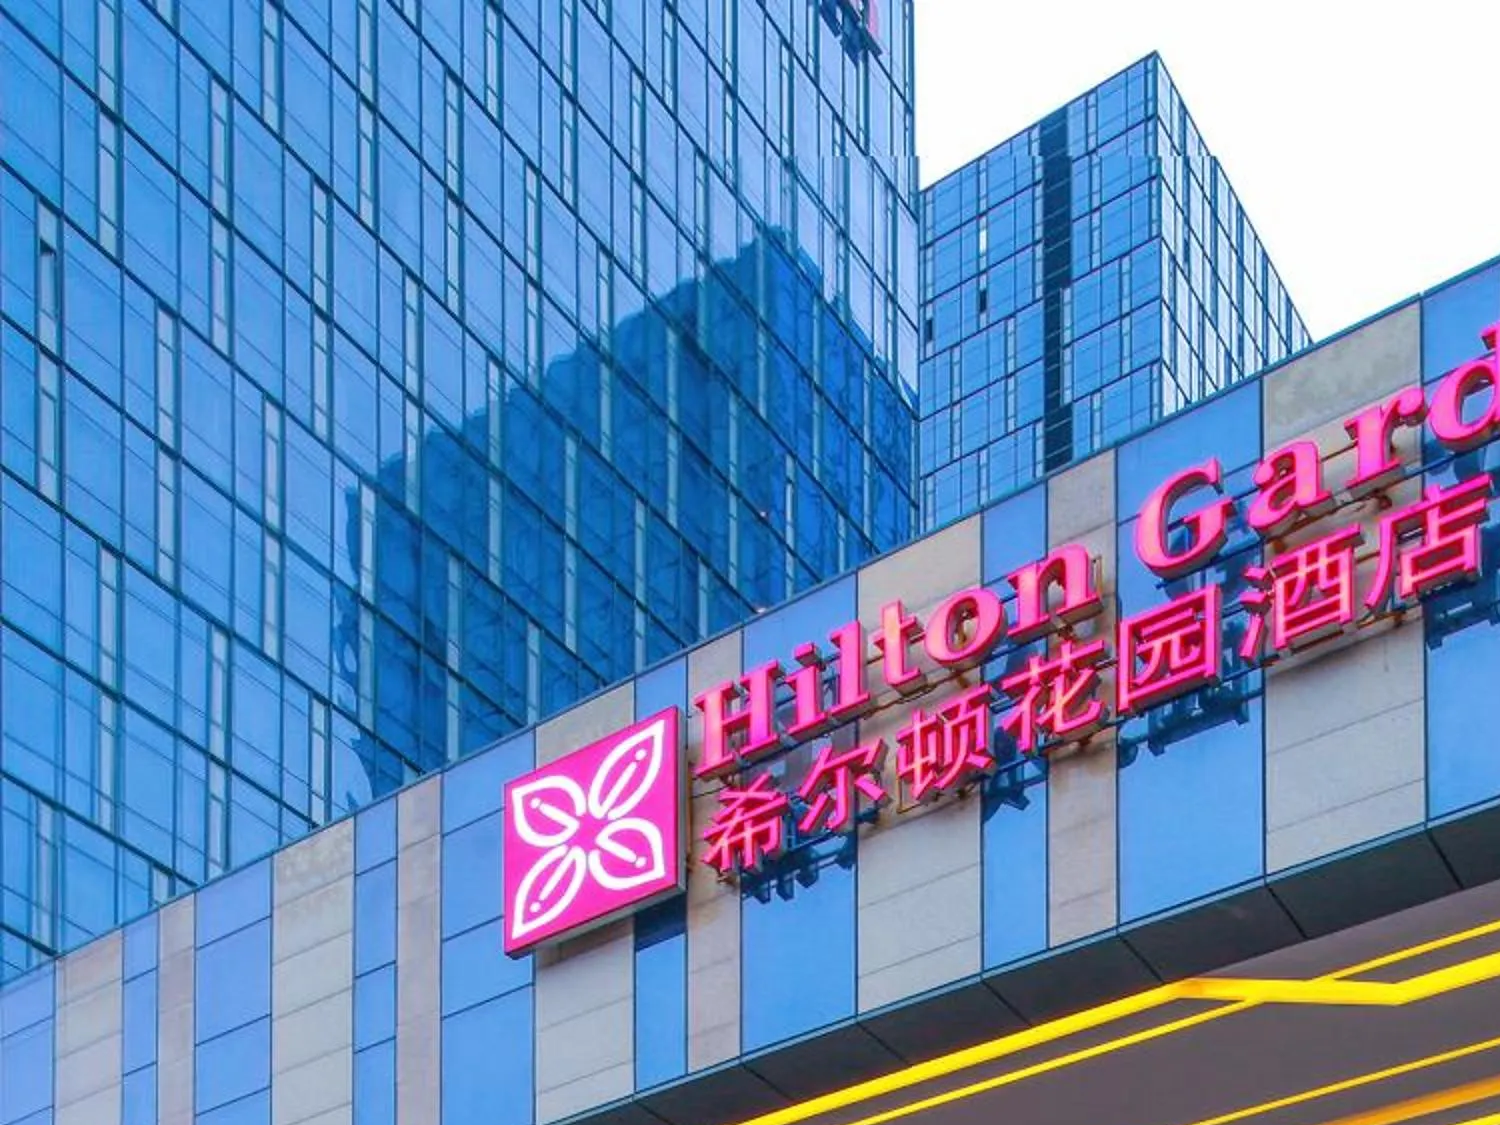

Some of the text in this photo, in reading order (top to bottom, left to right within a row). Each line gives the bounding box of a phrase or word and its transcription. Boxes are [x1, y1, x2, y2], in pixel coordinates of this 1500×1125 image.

[692, 542, 1097, 778] Hilton
[702, 473, 1495, 875] 希尔顿花园酒店
